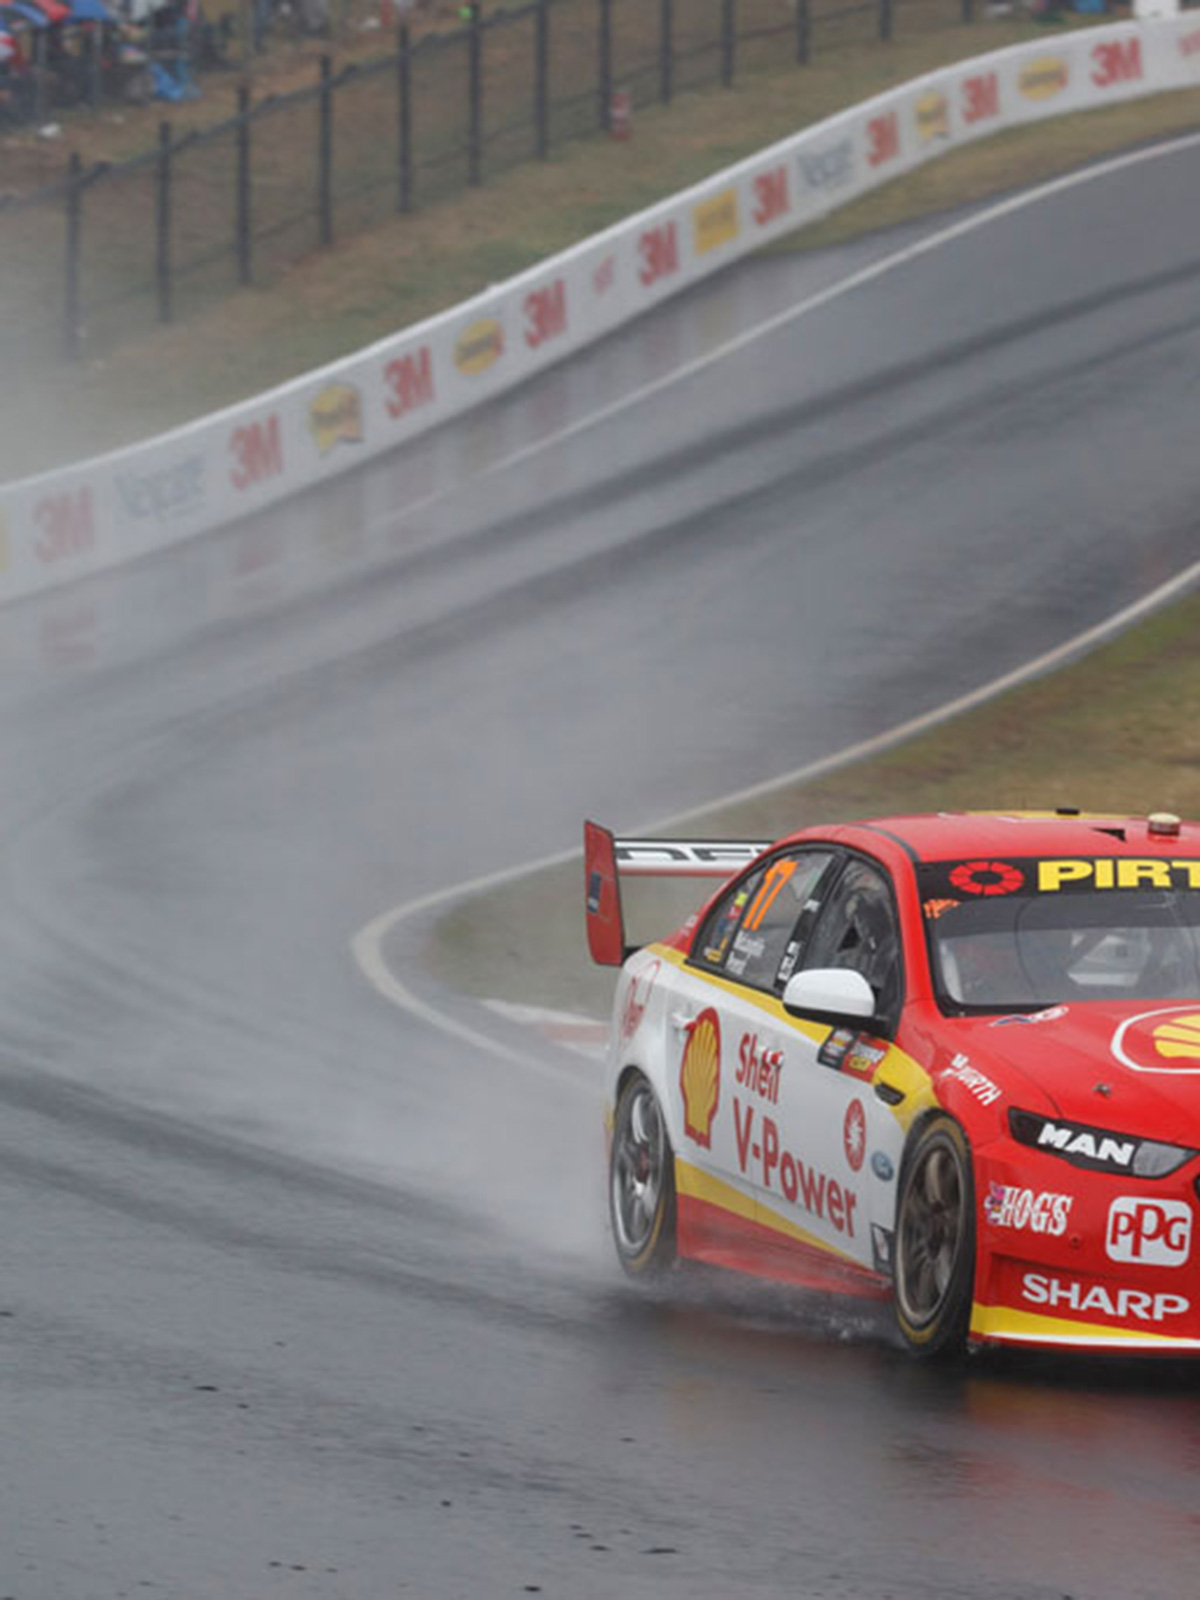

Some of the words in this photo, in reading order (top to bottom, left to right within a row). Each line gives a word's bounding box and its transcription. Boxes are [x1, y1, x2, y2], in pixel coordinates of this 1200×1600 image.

[1091, 37, 1142, 89] 3M
[638, 221, 679, 287] 3M
[524, 279, 566, 348] 3M
[384, 347, 434, 421] 3M
[230, 413, 284, 490] 3M
[735, 1031, 784, 1105] Shell
[732, 1096, 857, 1238] V-Power
[1037, 1122, 1135, 1166] MAN
[1001, 1184, 1073, 1236] HOGS
[1110, 1203, 1188, 1257] PPG
[1022, 1274, 1190, 1321] SHARP
